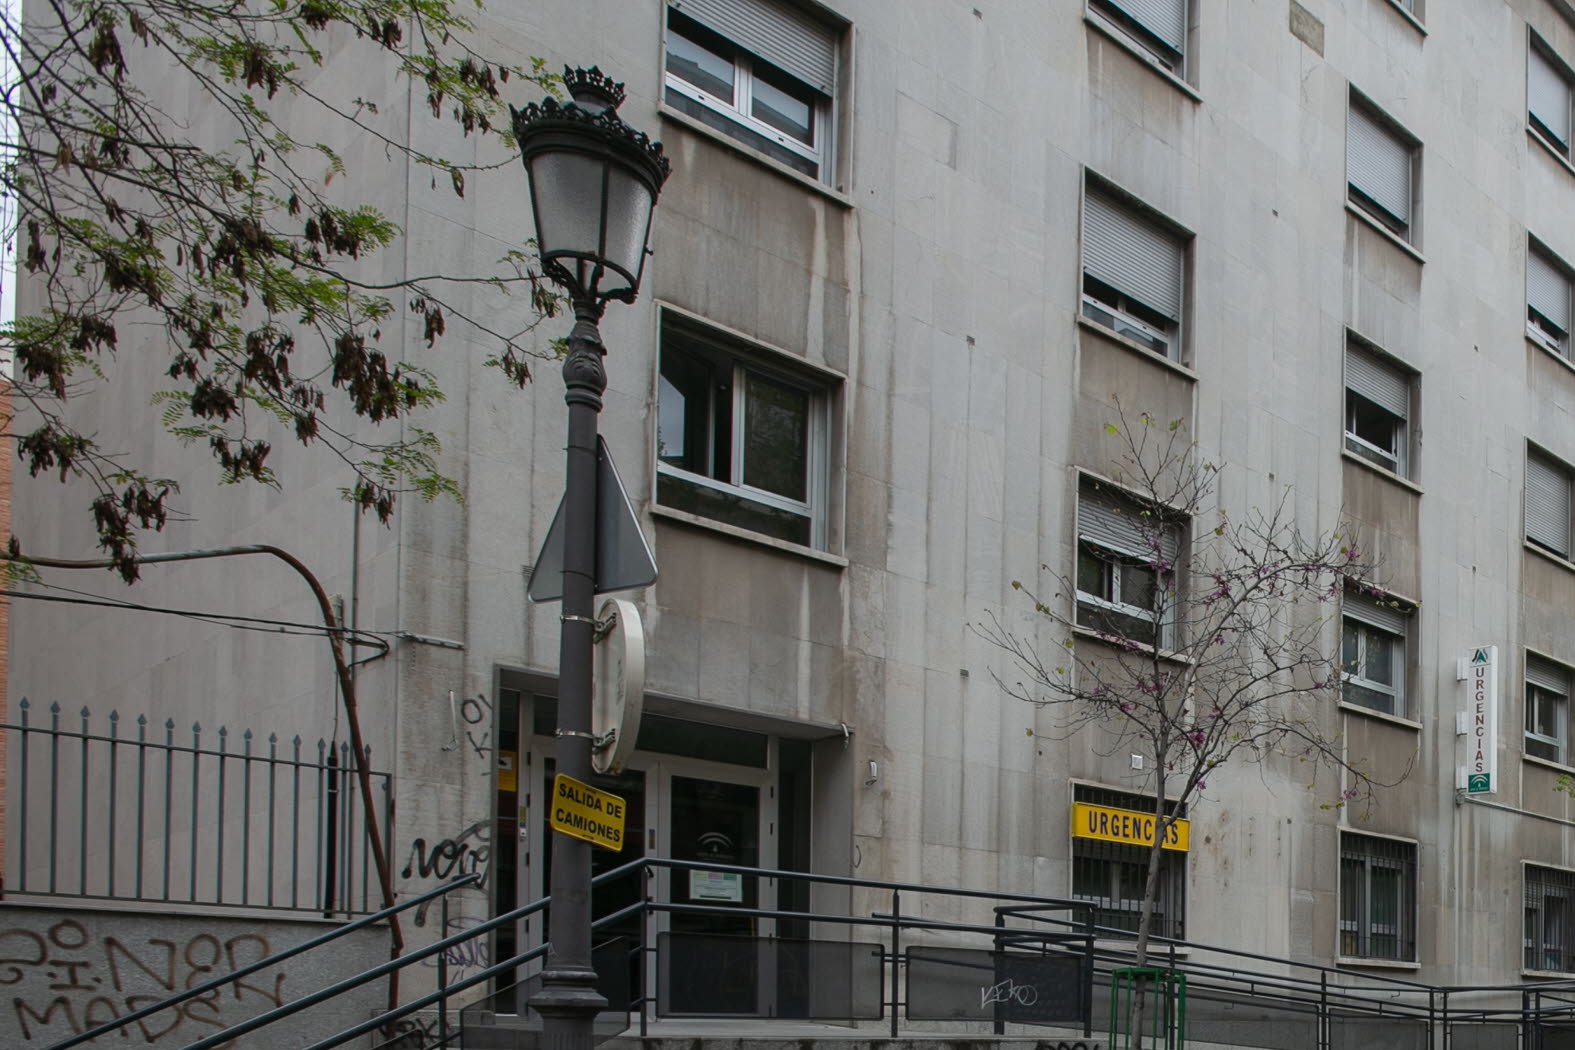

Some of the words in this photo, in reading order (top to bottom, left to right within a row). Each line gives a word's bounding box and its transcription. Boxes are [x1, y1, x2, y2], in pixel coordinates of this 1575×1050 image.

[1475, 667, 1485, 772] URGENCIAS
[559, 783, 602, 812] SALIDA
[605, 802, 622, 819] DE
[556, 808, 620, 842] CAMIONES
[1088, 811, 1178, 845] URGENCAS
